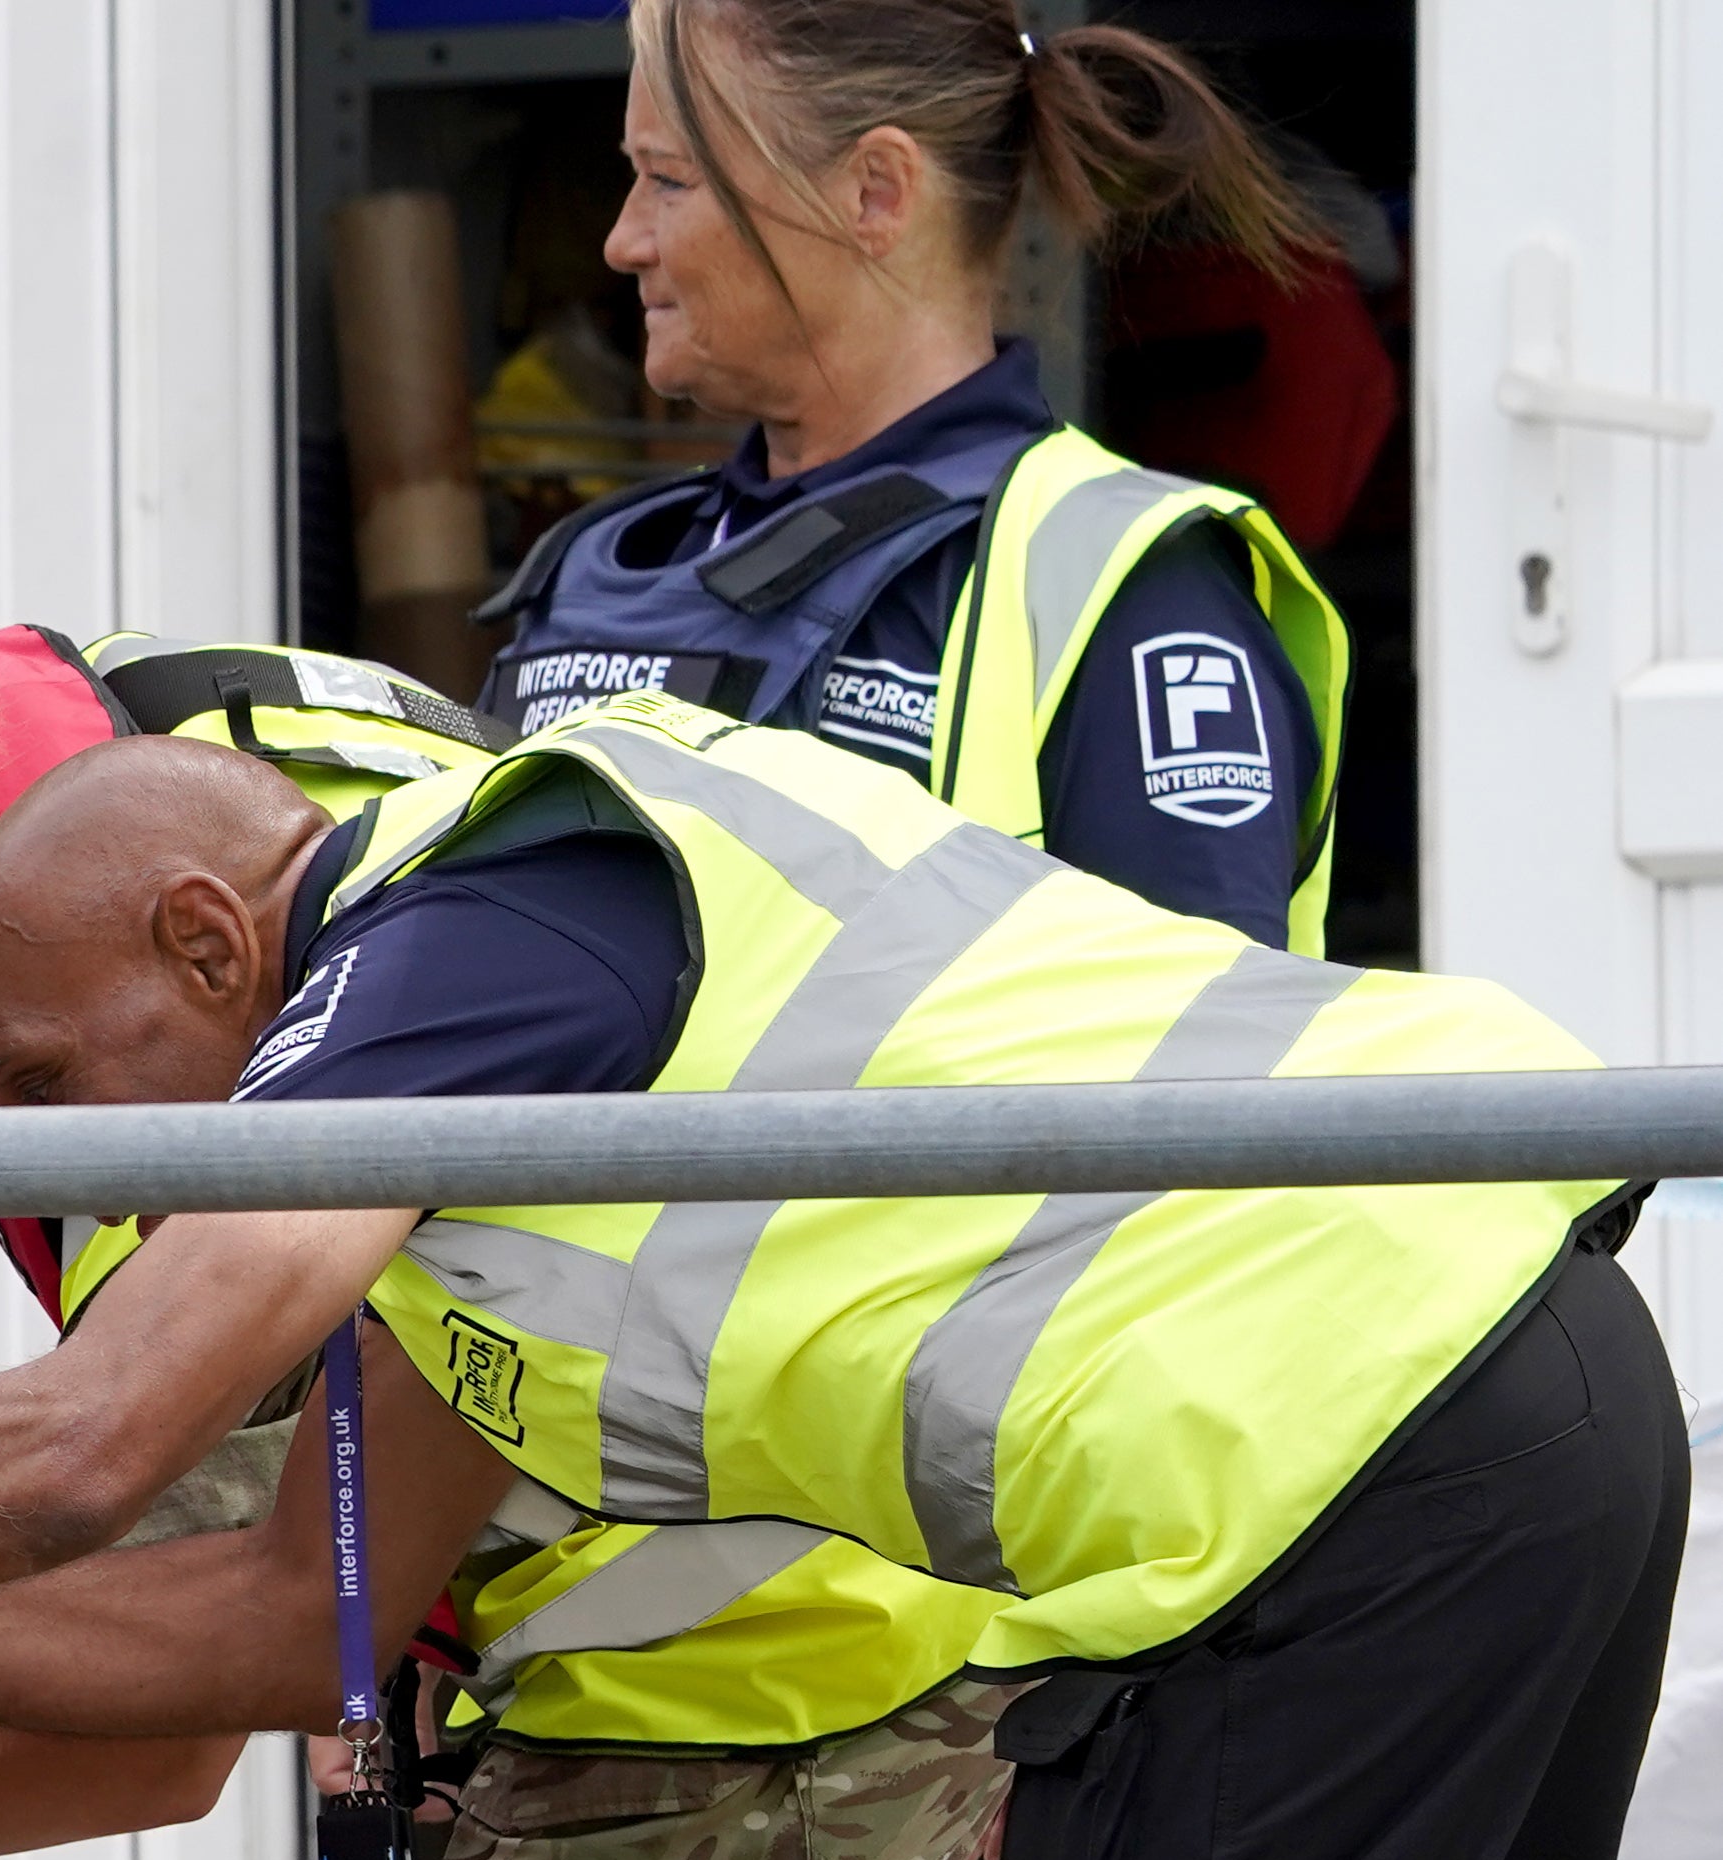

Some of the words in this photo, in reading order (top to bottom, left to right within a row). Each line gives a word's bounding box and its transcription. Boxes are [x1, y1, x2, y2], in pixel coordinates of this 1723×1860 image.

[516, 652, 672, 699] INTERFORCE
[823, 672, 937, 723] RFORCE
[521, 694, 592, 737] OFFIC
[1145, 765, 1273, 795] INTERFORCE
[330, 1407, 359, 1597] interforce.org.uk
